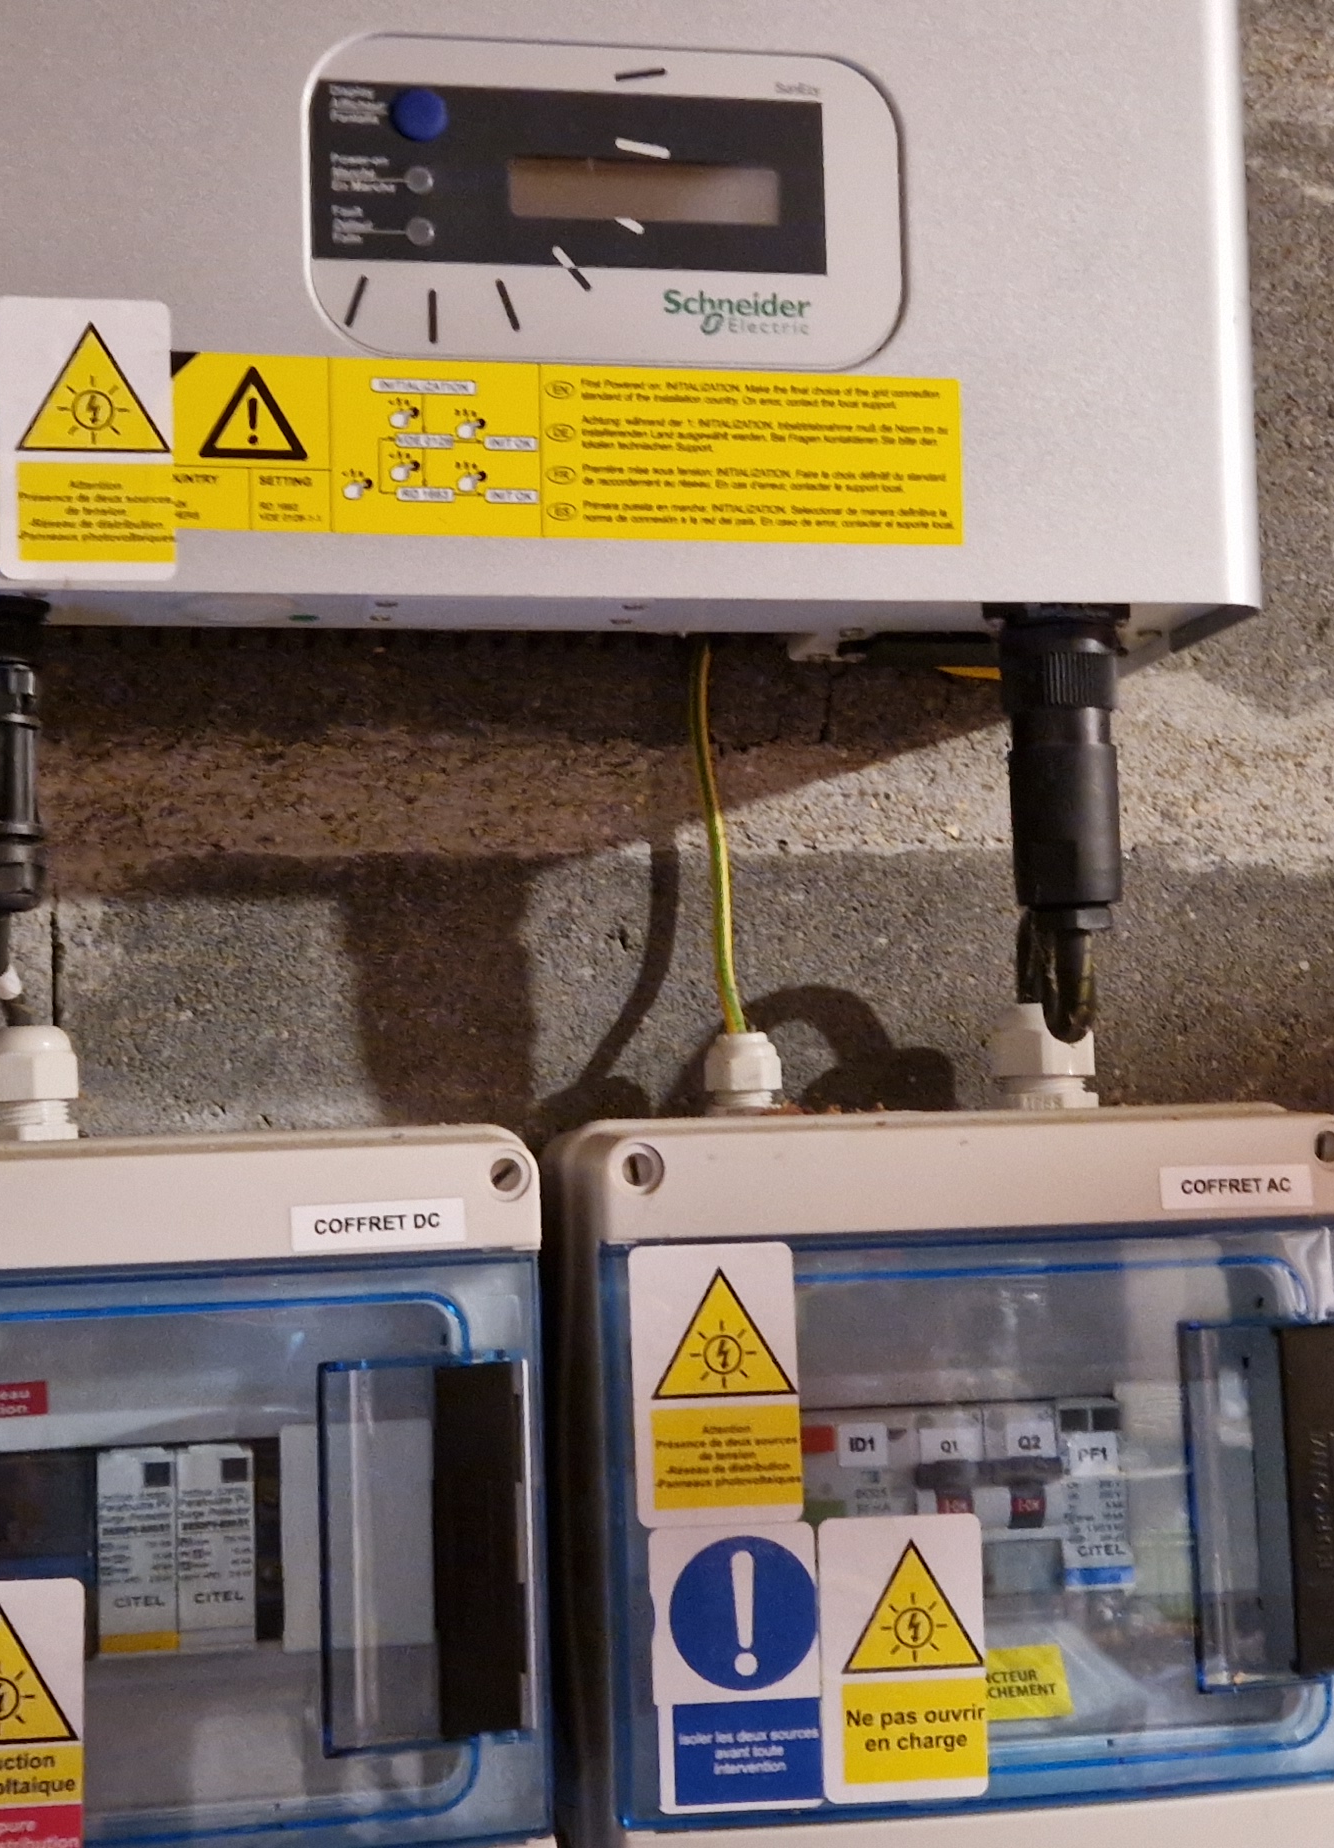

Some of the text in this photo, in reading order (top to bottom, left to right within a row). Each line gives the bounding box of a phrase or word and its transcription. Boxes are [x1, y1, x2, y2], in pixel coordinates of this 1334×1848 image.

[663, 289, 812, 318] Schneider
[728, 316, 810, 335] Electric
[259, 475, 312, 487] SETTING
[1180, 1176, 1292, 1195] COFFRET AC
[314, 1211, 441, 1235] COFFRET DC
[709, 1437, 723, 1448] de
[849, 1435, 876, 1453] ID1
[940, 1439, 959, 1454] Q1
[1017, 1435, 1043, 1451] Q2
[699, 1451, 713, 1461] de
[712, 1463, 726, 1474] de
[1077, 1543, 1126, 1557] CITEL
[114, 1595, 166, 1608] CITEL
[194, 1590, 244, 1604] CITEL
[986, 1669, 1038, 1684] CTEUR
[986, 1682, 1057, 1699] CHEMENT
[846, 1703, 985, 1730] Ne pas ouvrir
[714, 1730, 735, 1744] les
[736, 1729, 768, 1743] deux
[864, 1731, 968, 1753] en charge
[714, 1744, 785, 1760] avant toute
